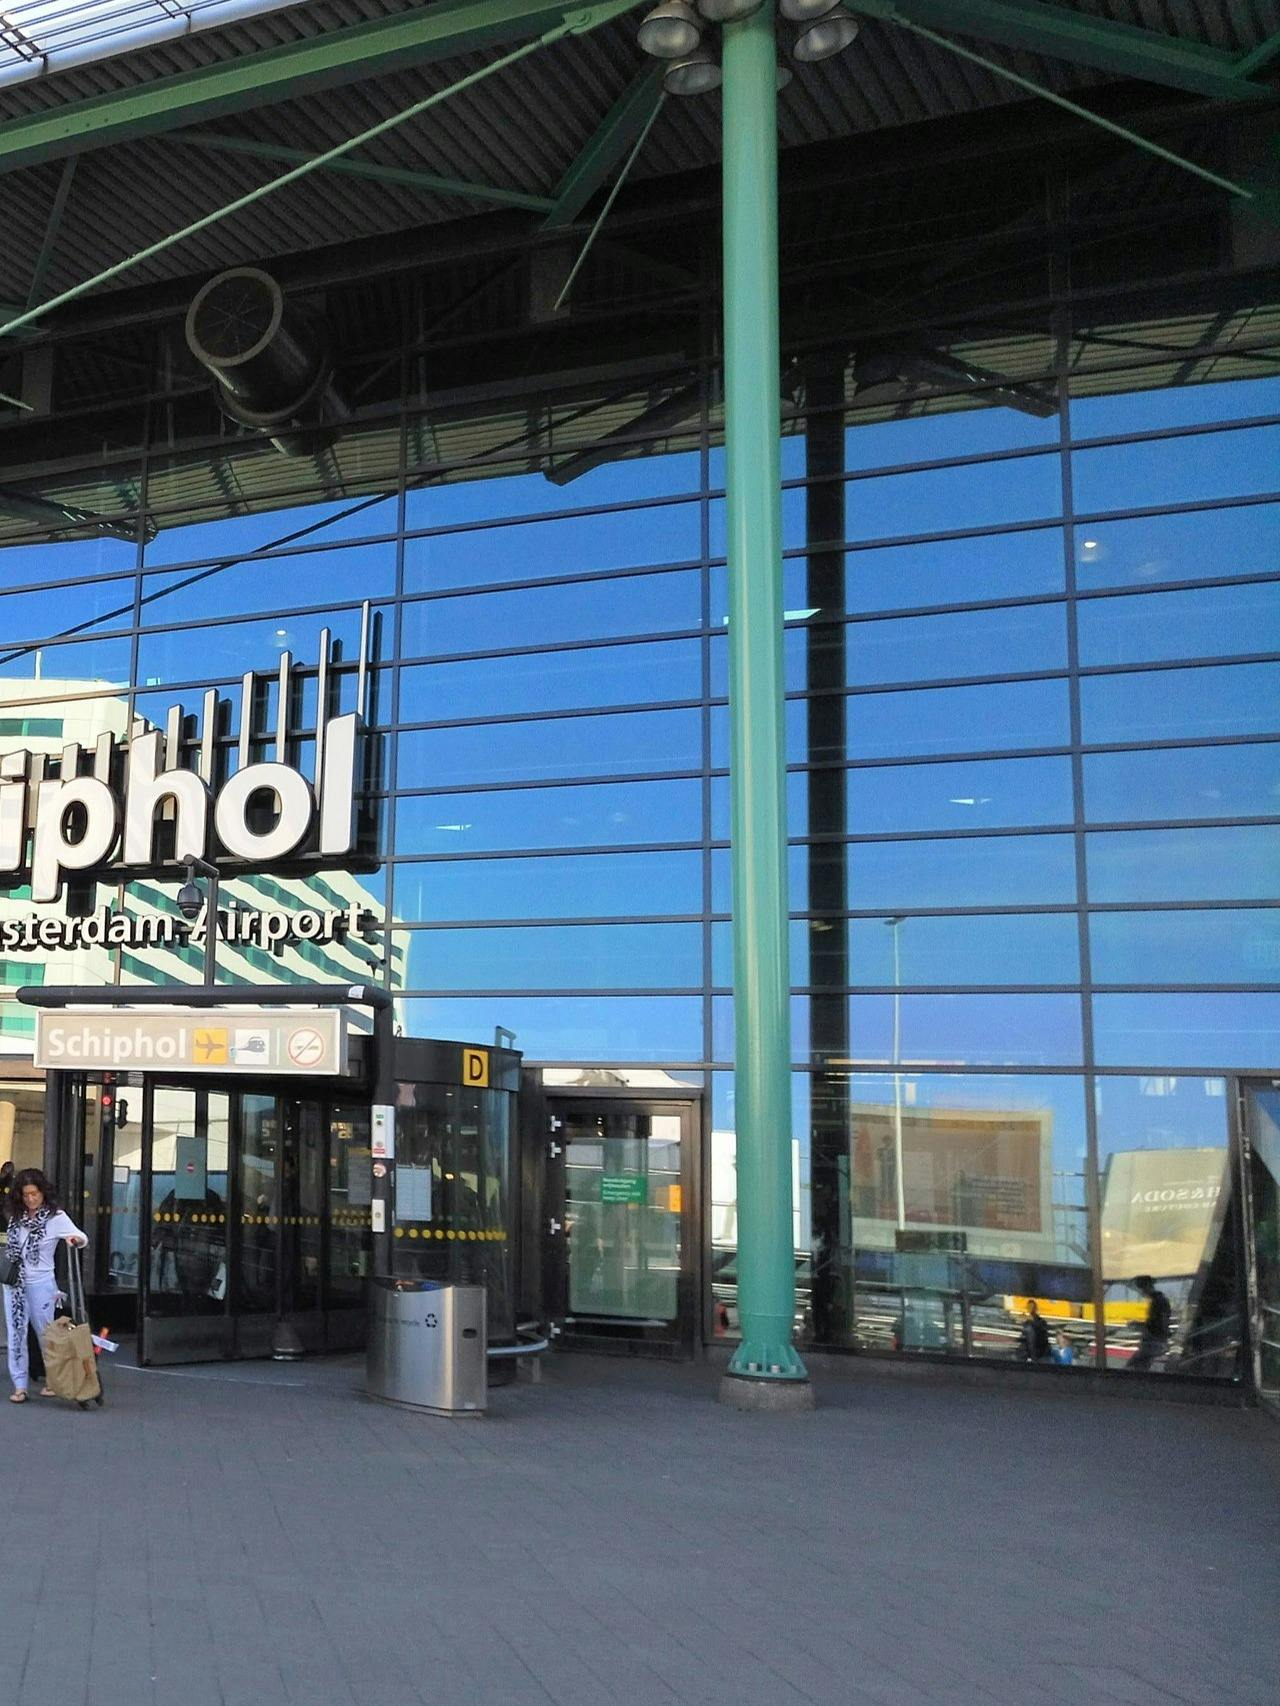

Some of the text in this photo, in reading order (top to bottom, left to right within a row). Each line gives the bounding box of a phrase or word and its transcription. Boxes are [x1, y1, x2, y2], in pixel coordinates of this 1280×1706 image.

[187, 901, 365, 951] Airport
[48, 1027, 187, 1064] Schiphol
[469, 1053, 484, 1081] D
